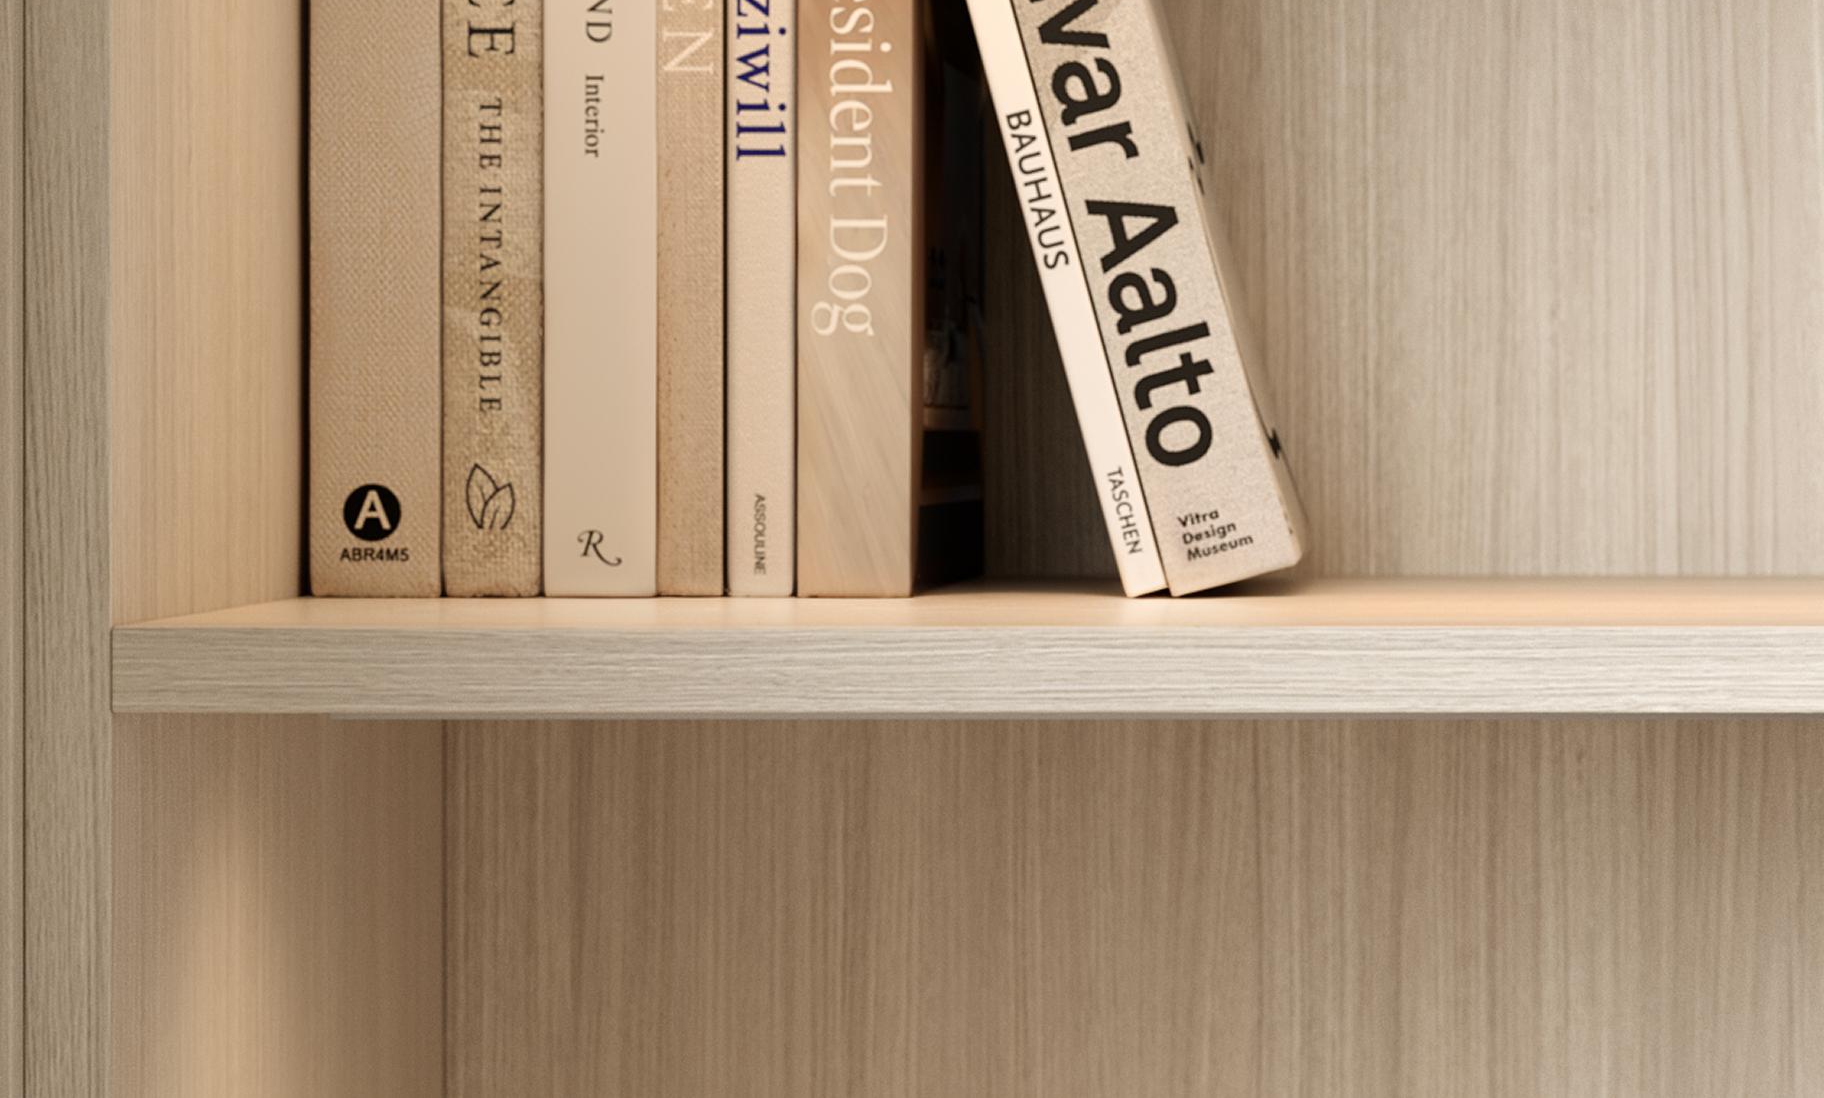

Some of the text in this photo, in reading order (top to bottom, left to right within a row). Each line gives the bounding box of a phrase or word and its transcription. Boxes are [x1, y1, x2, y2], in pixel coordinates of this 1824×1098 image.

[585, 75, 605, 158] Interior
[1005, 110, 1070, 270] BAUHAUS
[479, 98, 502, 412] THE INTANGIBLE
[811, 214, 888, 336] Dog
[1085, 200, 1213, 467] Aalto
[354, 490, 392, 530] A
[1107, 466, 1143, 555] TASCHEN
[1177, 510, 1220, 527] Vitra
[1182, 522, 1237, 545] Design
[1187, 536, 1253, 561] Museum
